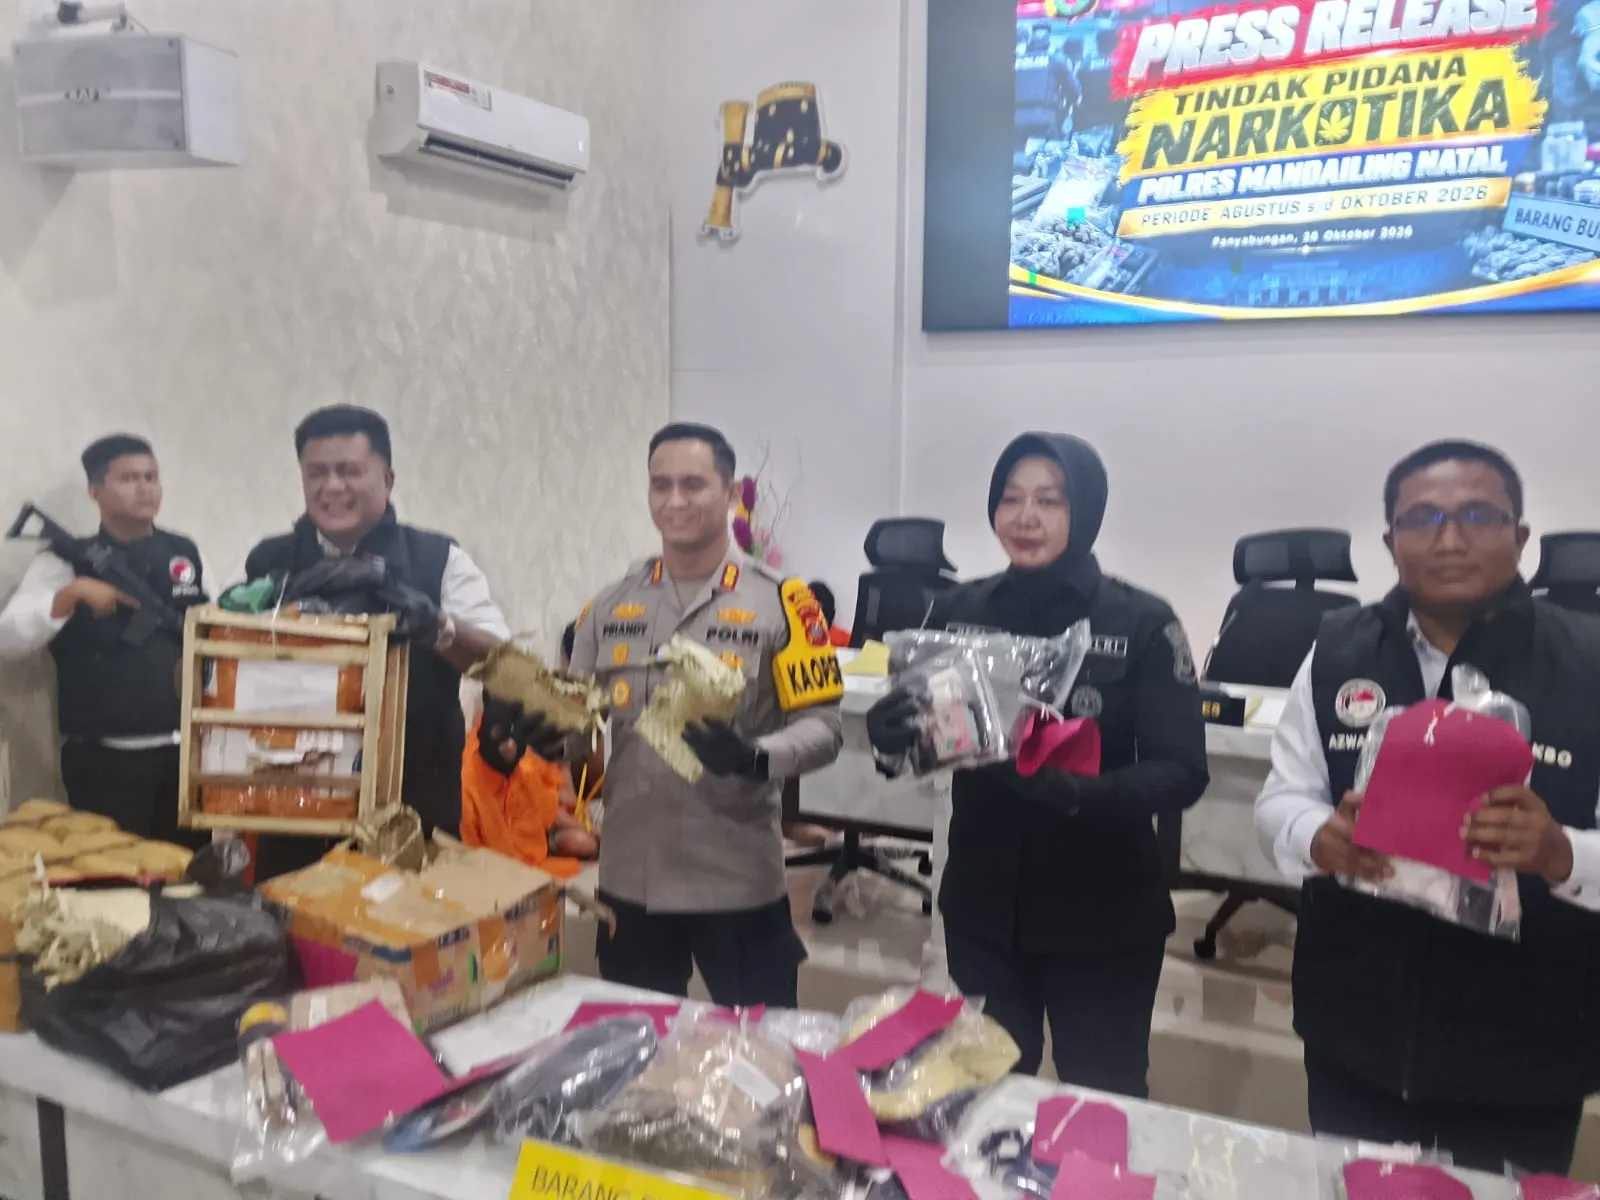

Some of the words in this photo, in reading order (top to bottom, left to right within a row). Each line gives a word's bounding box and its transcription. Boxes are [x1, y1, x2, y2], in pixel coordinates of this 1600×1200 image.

[1127, 4, 1299, 80] PRESS
[1304, 0, 1537, 56] RELEASE
[1174, 73, 1312, 115] TINDAK
[1323, 55, 1467, 95] PIDANA
[1141, 78, 1510, 170] NARKOTIKA
[1137, 168, 1237, 205] POLRES
[1237, 151, 1413, 193] MANDAILING
[1414, 145, 1508, 178] NATAL
[1141, 208, 1212, 227] PERIODE
[1219, 200, 1301, 220] AGUSTUS
[1340, 190, 1429, 209] OKTOBER
[1514, 207, 1573, 233] BARANG
[706, 626, 760, 646] POLRI
